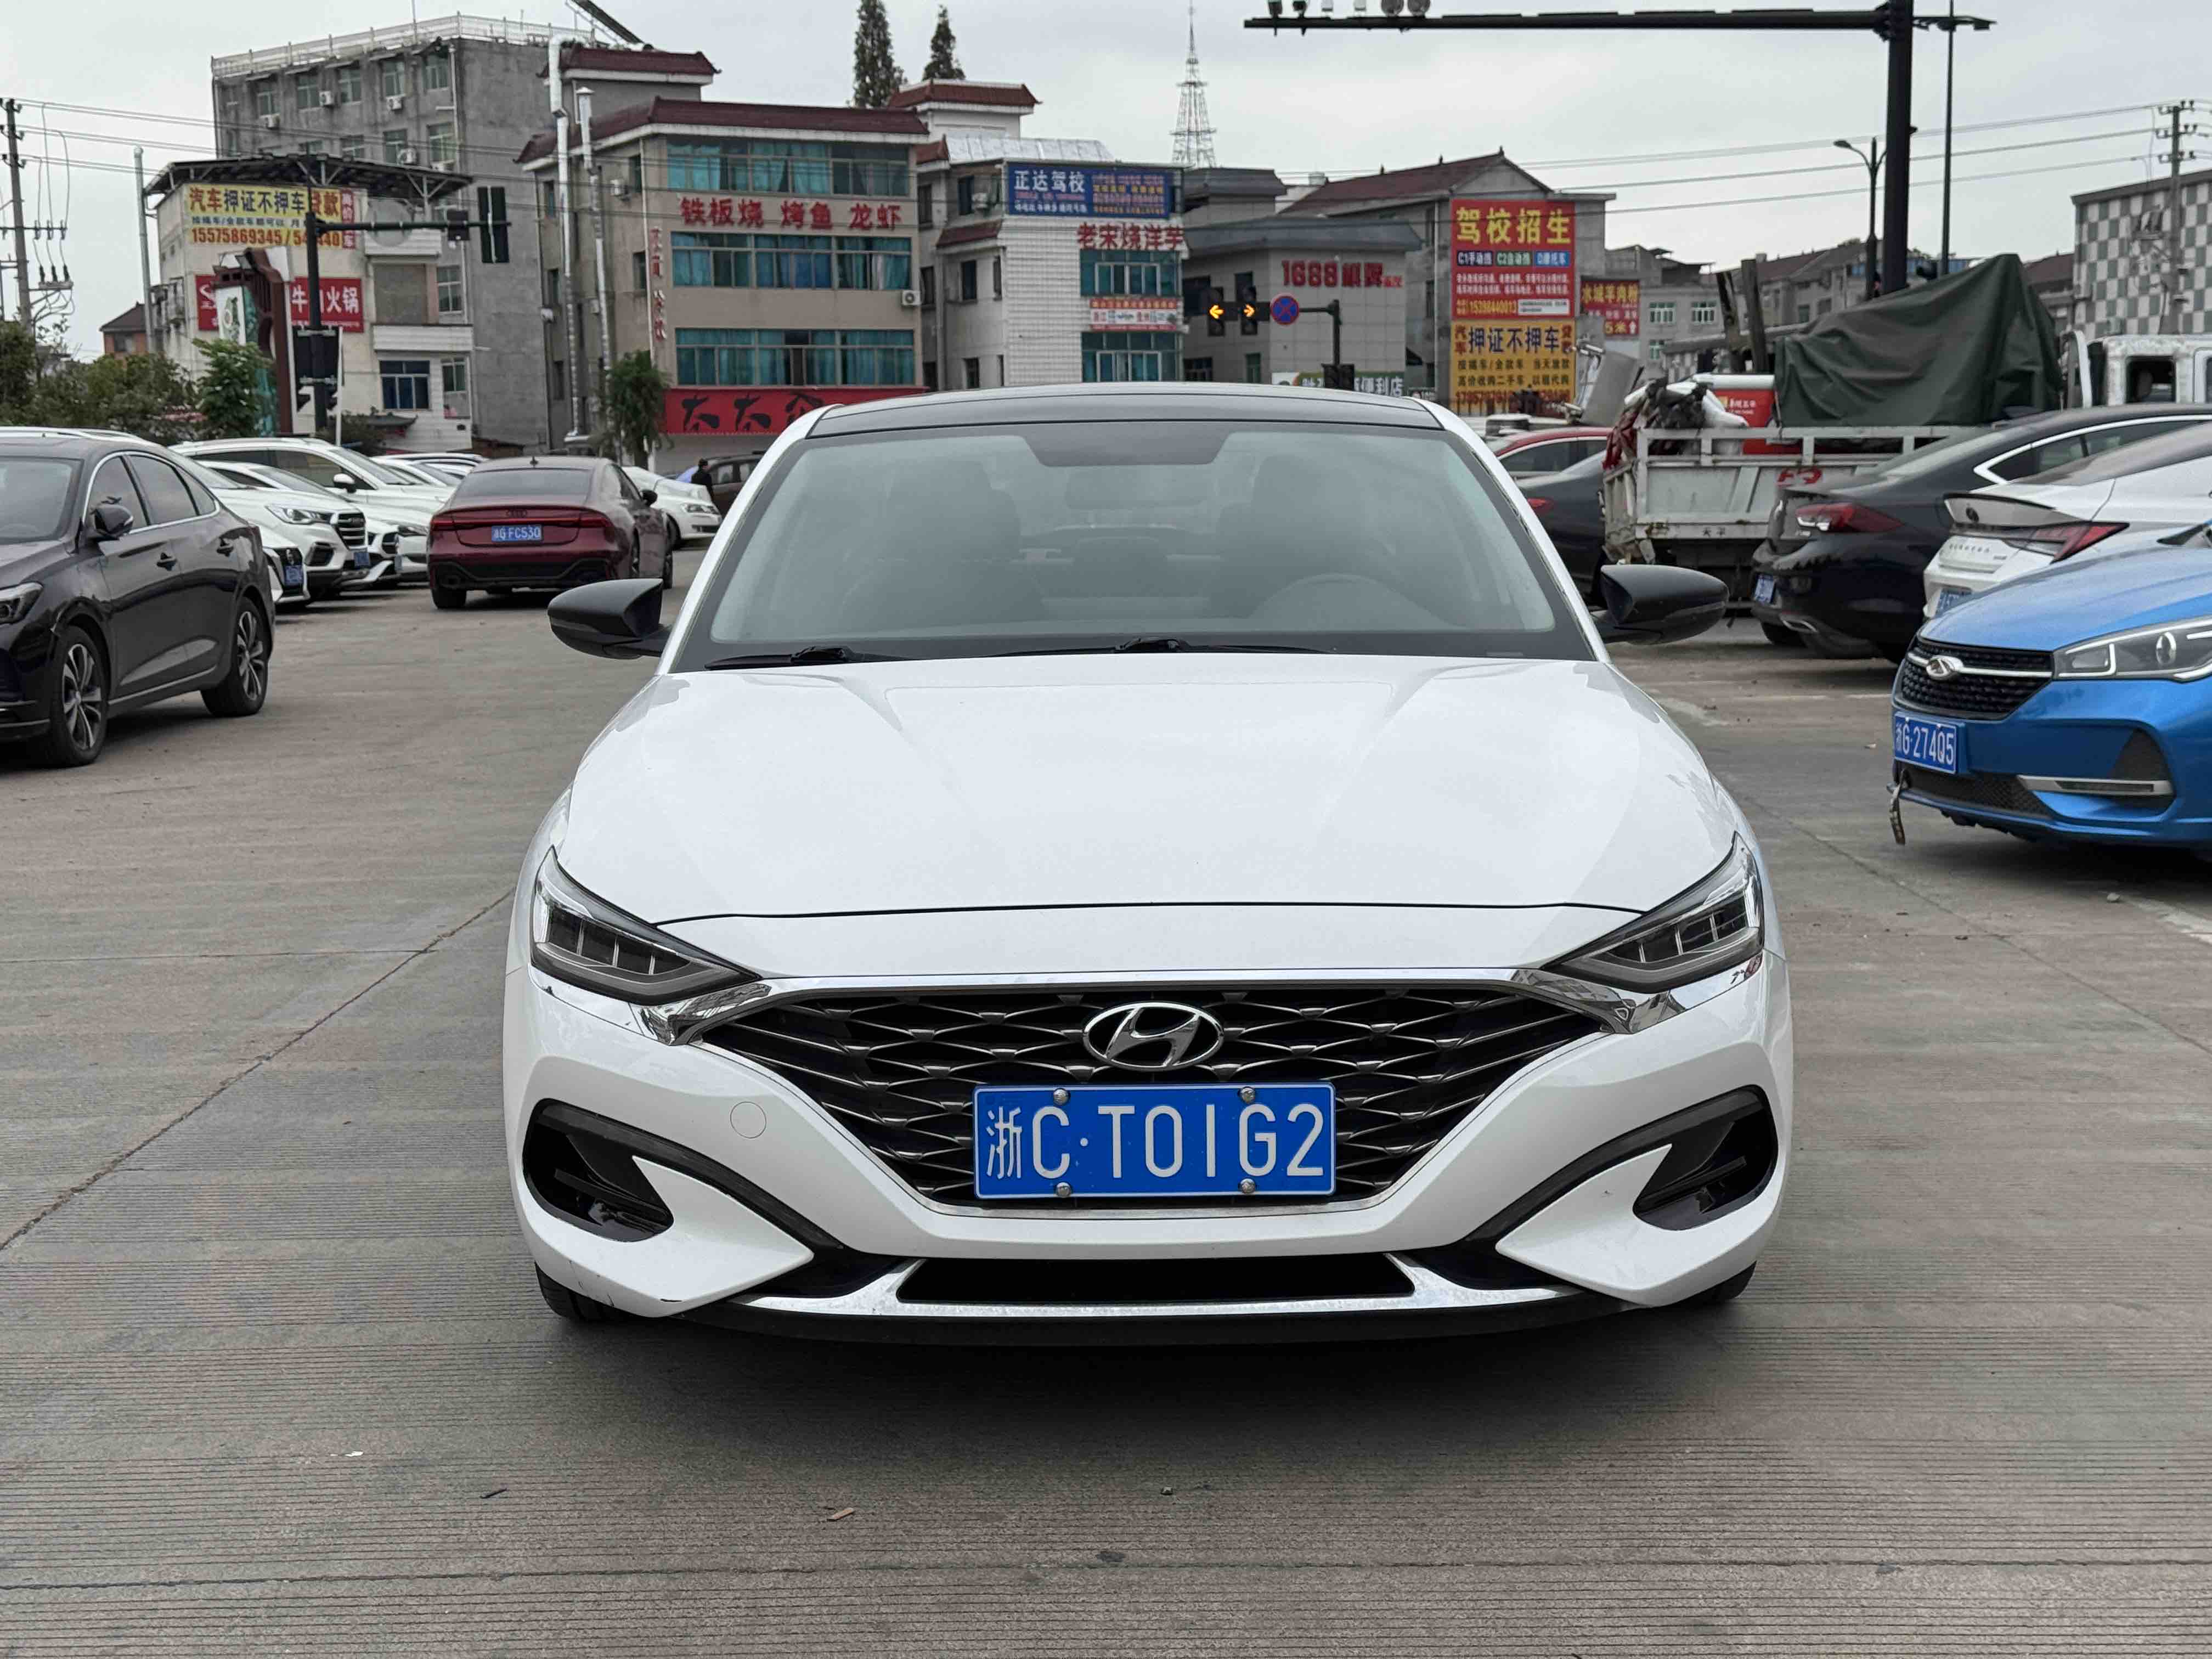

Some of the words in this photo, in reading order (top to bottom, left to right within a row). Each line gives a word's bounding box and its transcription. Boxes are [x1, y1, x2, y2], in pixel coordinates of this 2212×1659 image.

[1014, 170, 1086, 193] 正达驾校
[189, 187, 339, 216] 汽车押证不押车贷款
[680, 196, 765, 228] 铁板烧
[780, 200, 833, 231] 烤鱼
[849, 202, 902, 232] 龙虾
[1456, 207, 1571, 245] 驾校招生
[291, 285, 360, 314] 牛火锅
[1468, 326, 1560, 353] 押证不押车
[985, 1103, 1324, 1180] 浙C·T01G2
